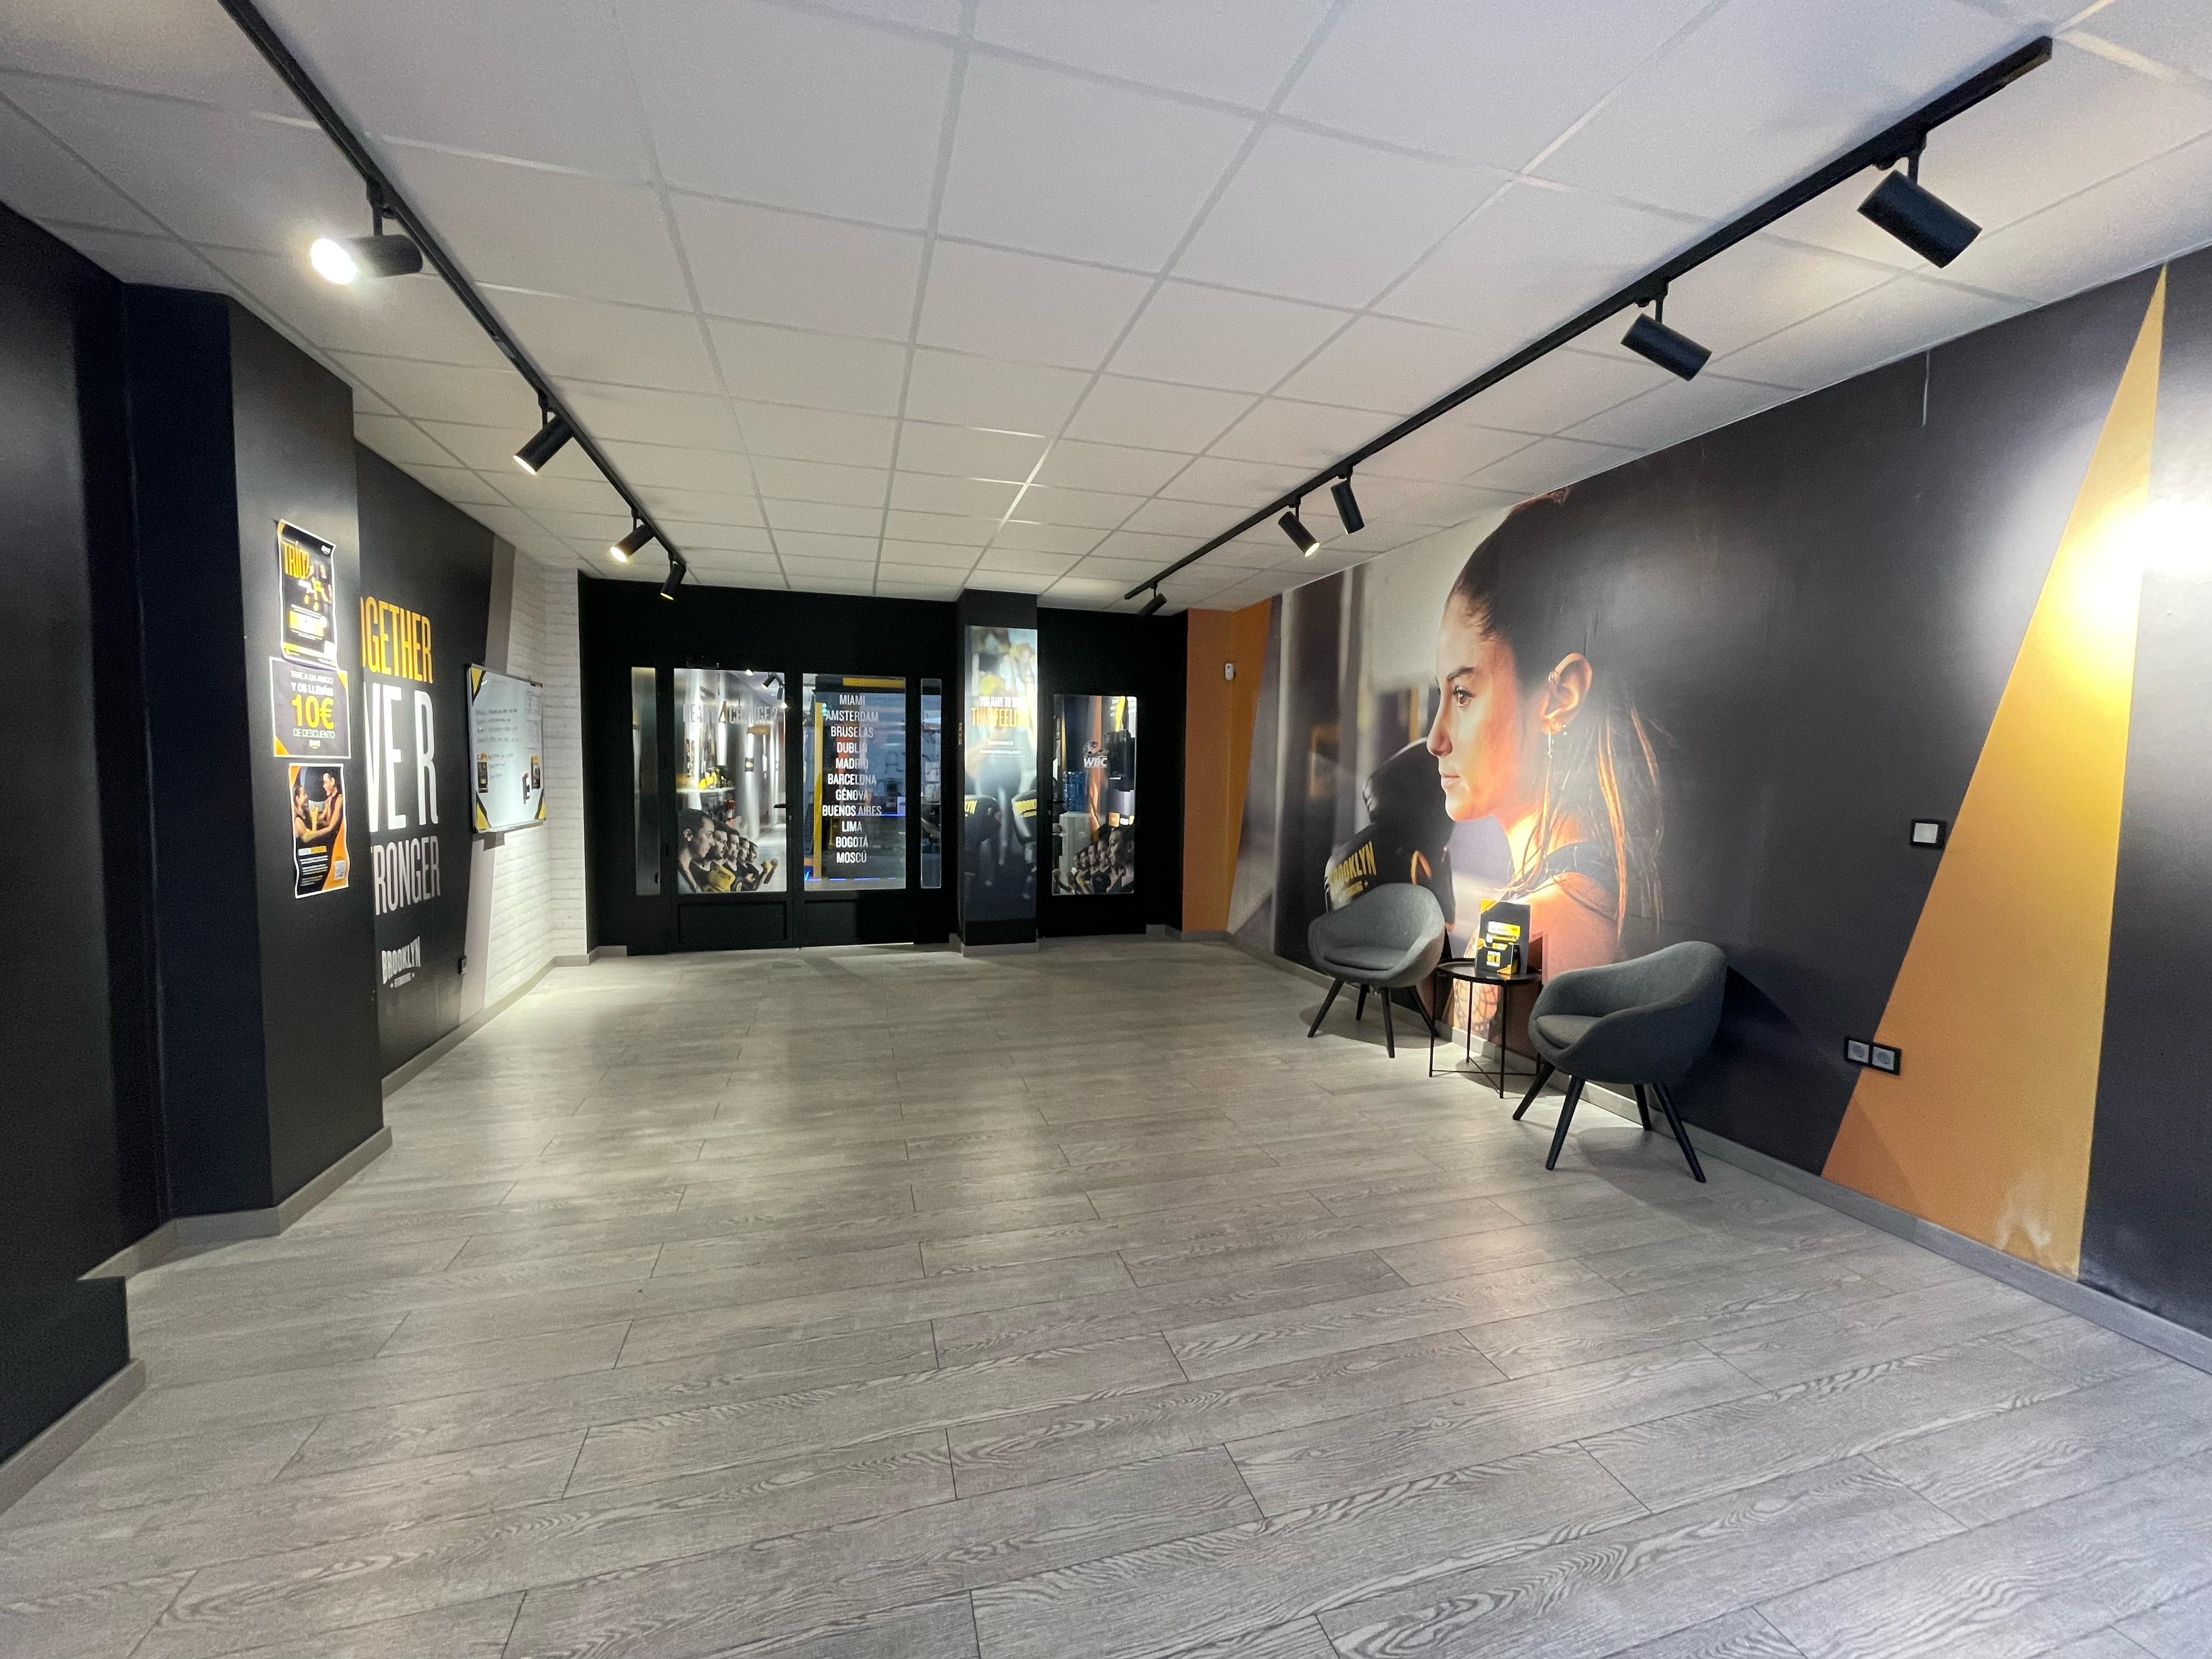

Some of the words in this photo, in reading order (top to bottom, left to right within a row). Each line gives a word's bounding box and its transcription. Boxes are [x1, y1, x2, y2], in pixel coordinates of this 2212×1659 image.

[839, 694, 865, 706] MIAMI
[291, 694, 334, 730] 10€
[825, 710, 878, 722] AMSTERDAM
[994, 707, 1030, 728] FEELI
[831, 726, 874, 738] BRUSELAS
[837, 742, 868, 753] DUBLIN
[414, 690, 438, 826] R
[836, 757, 869, 769] MADRID
[1083, 758, 1108, 767] WBC
[827, 774, 877, 786] BARCELONA
[836, 787, 869, 801] GÉNOVA
[822, 805, 856, 816] BUENOS
[858, 805, 882, 816] AIRES
[842, 821, 862, 832] LIMA
[836, 834, 868, 848] BOGOTÁ
[836, 850, 867, 864] MOSCÚ
[370, 836, 441, 916] RONGER
